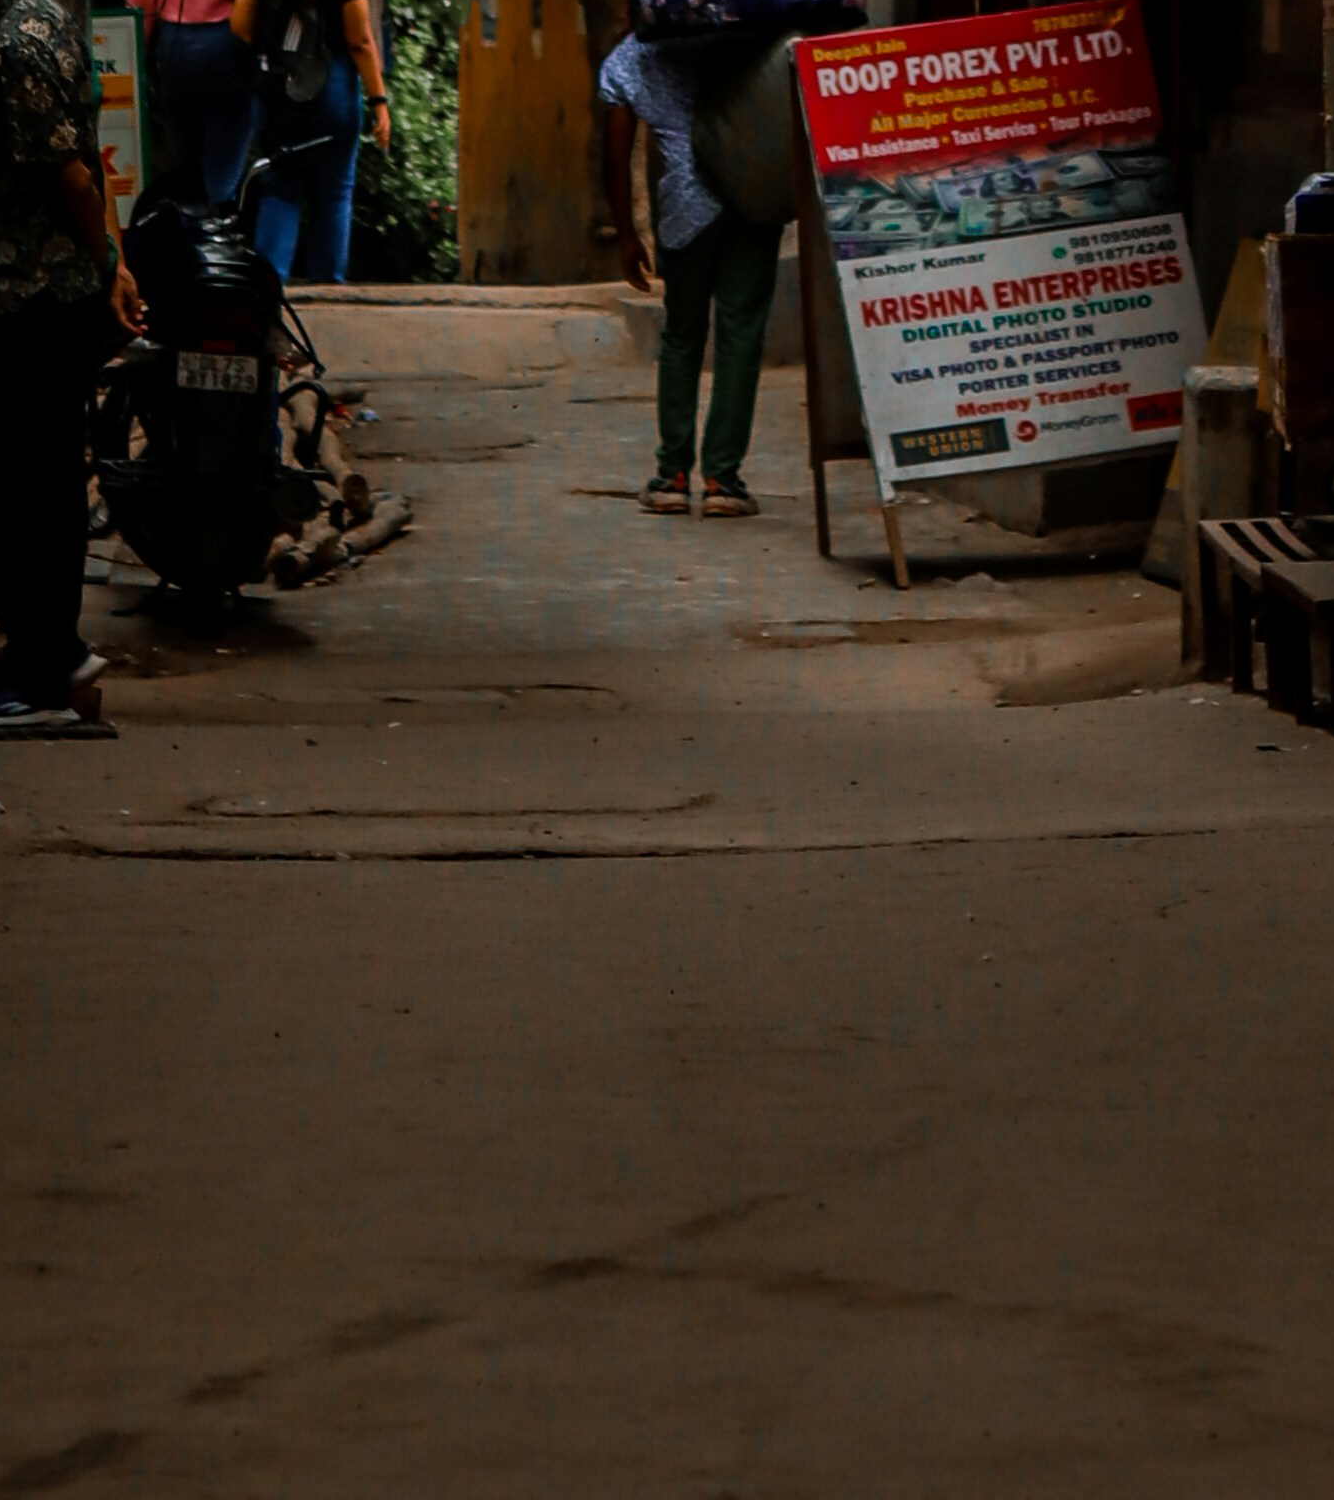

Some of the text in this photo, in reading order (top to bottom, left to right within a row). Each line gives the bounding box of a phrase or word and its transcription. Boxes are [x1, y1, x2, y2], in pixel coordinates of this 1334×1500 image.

[816, 28, 1134, 98] ROOP FOREX PVT. LTD.
[903, 82, 986, 110] Purchase
[1008, 75, 1049, 94] Sale
[826, 139, 858, 162] Visa
[861, 134, 940, 161] Assistance
[951, 125, 980, 147] Taxi
[981, 122, 1038, 144] Service
[1082, 105, 1153, 130] Packages
[870, 112, 895, 135] All
[898, 106, 948, 134] Major
[952, 96, 1047, 125] Currencies
[854, 250, 986, 280] Kishor Kumar
[861, 257, 1183, 329] KRISHNA ENTERPRISES
[902, 294, 1153, 344] DIGITAL PHOTO STUDIO
[968, 323, 1095, 354] SPECIALIST IN
[891, 331, 1180, 386] VISA PHOTO & PASSPORT PHOTO
[958, 360, 1122, 396] PORTER SERVICES
[956, 380, 1131, 420] Money Transfer
[900, 424, 985, 450] WESTERN
